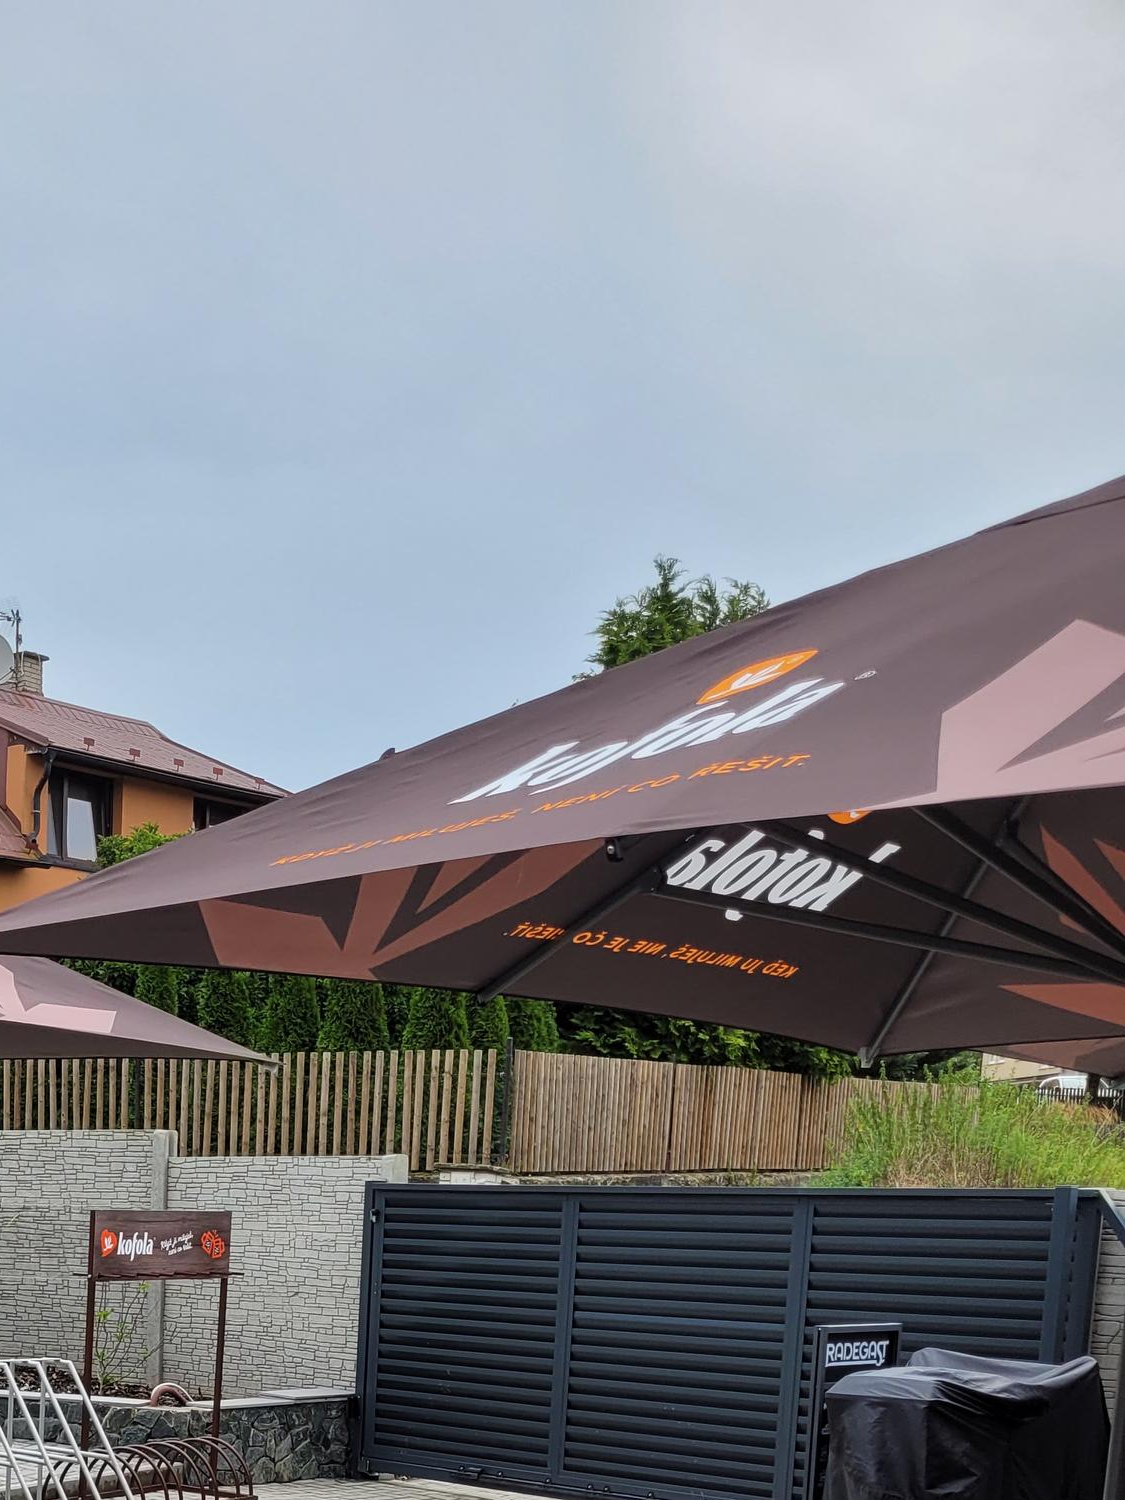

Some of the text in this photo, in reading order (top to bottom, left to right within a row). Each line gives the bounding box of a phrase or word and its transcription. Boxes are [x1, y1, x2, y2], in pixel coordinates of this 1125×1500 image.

[627, 774, 681, 793] CO
[688, 754, 811, 780] ŘEŠIT.
[117, 1232, 153, 1261] kofola
[825, 1340, 889, 1367] RADEGAST
